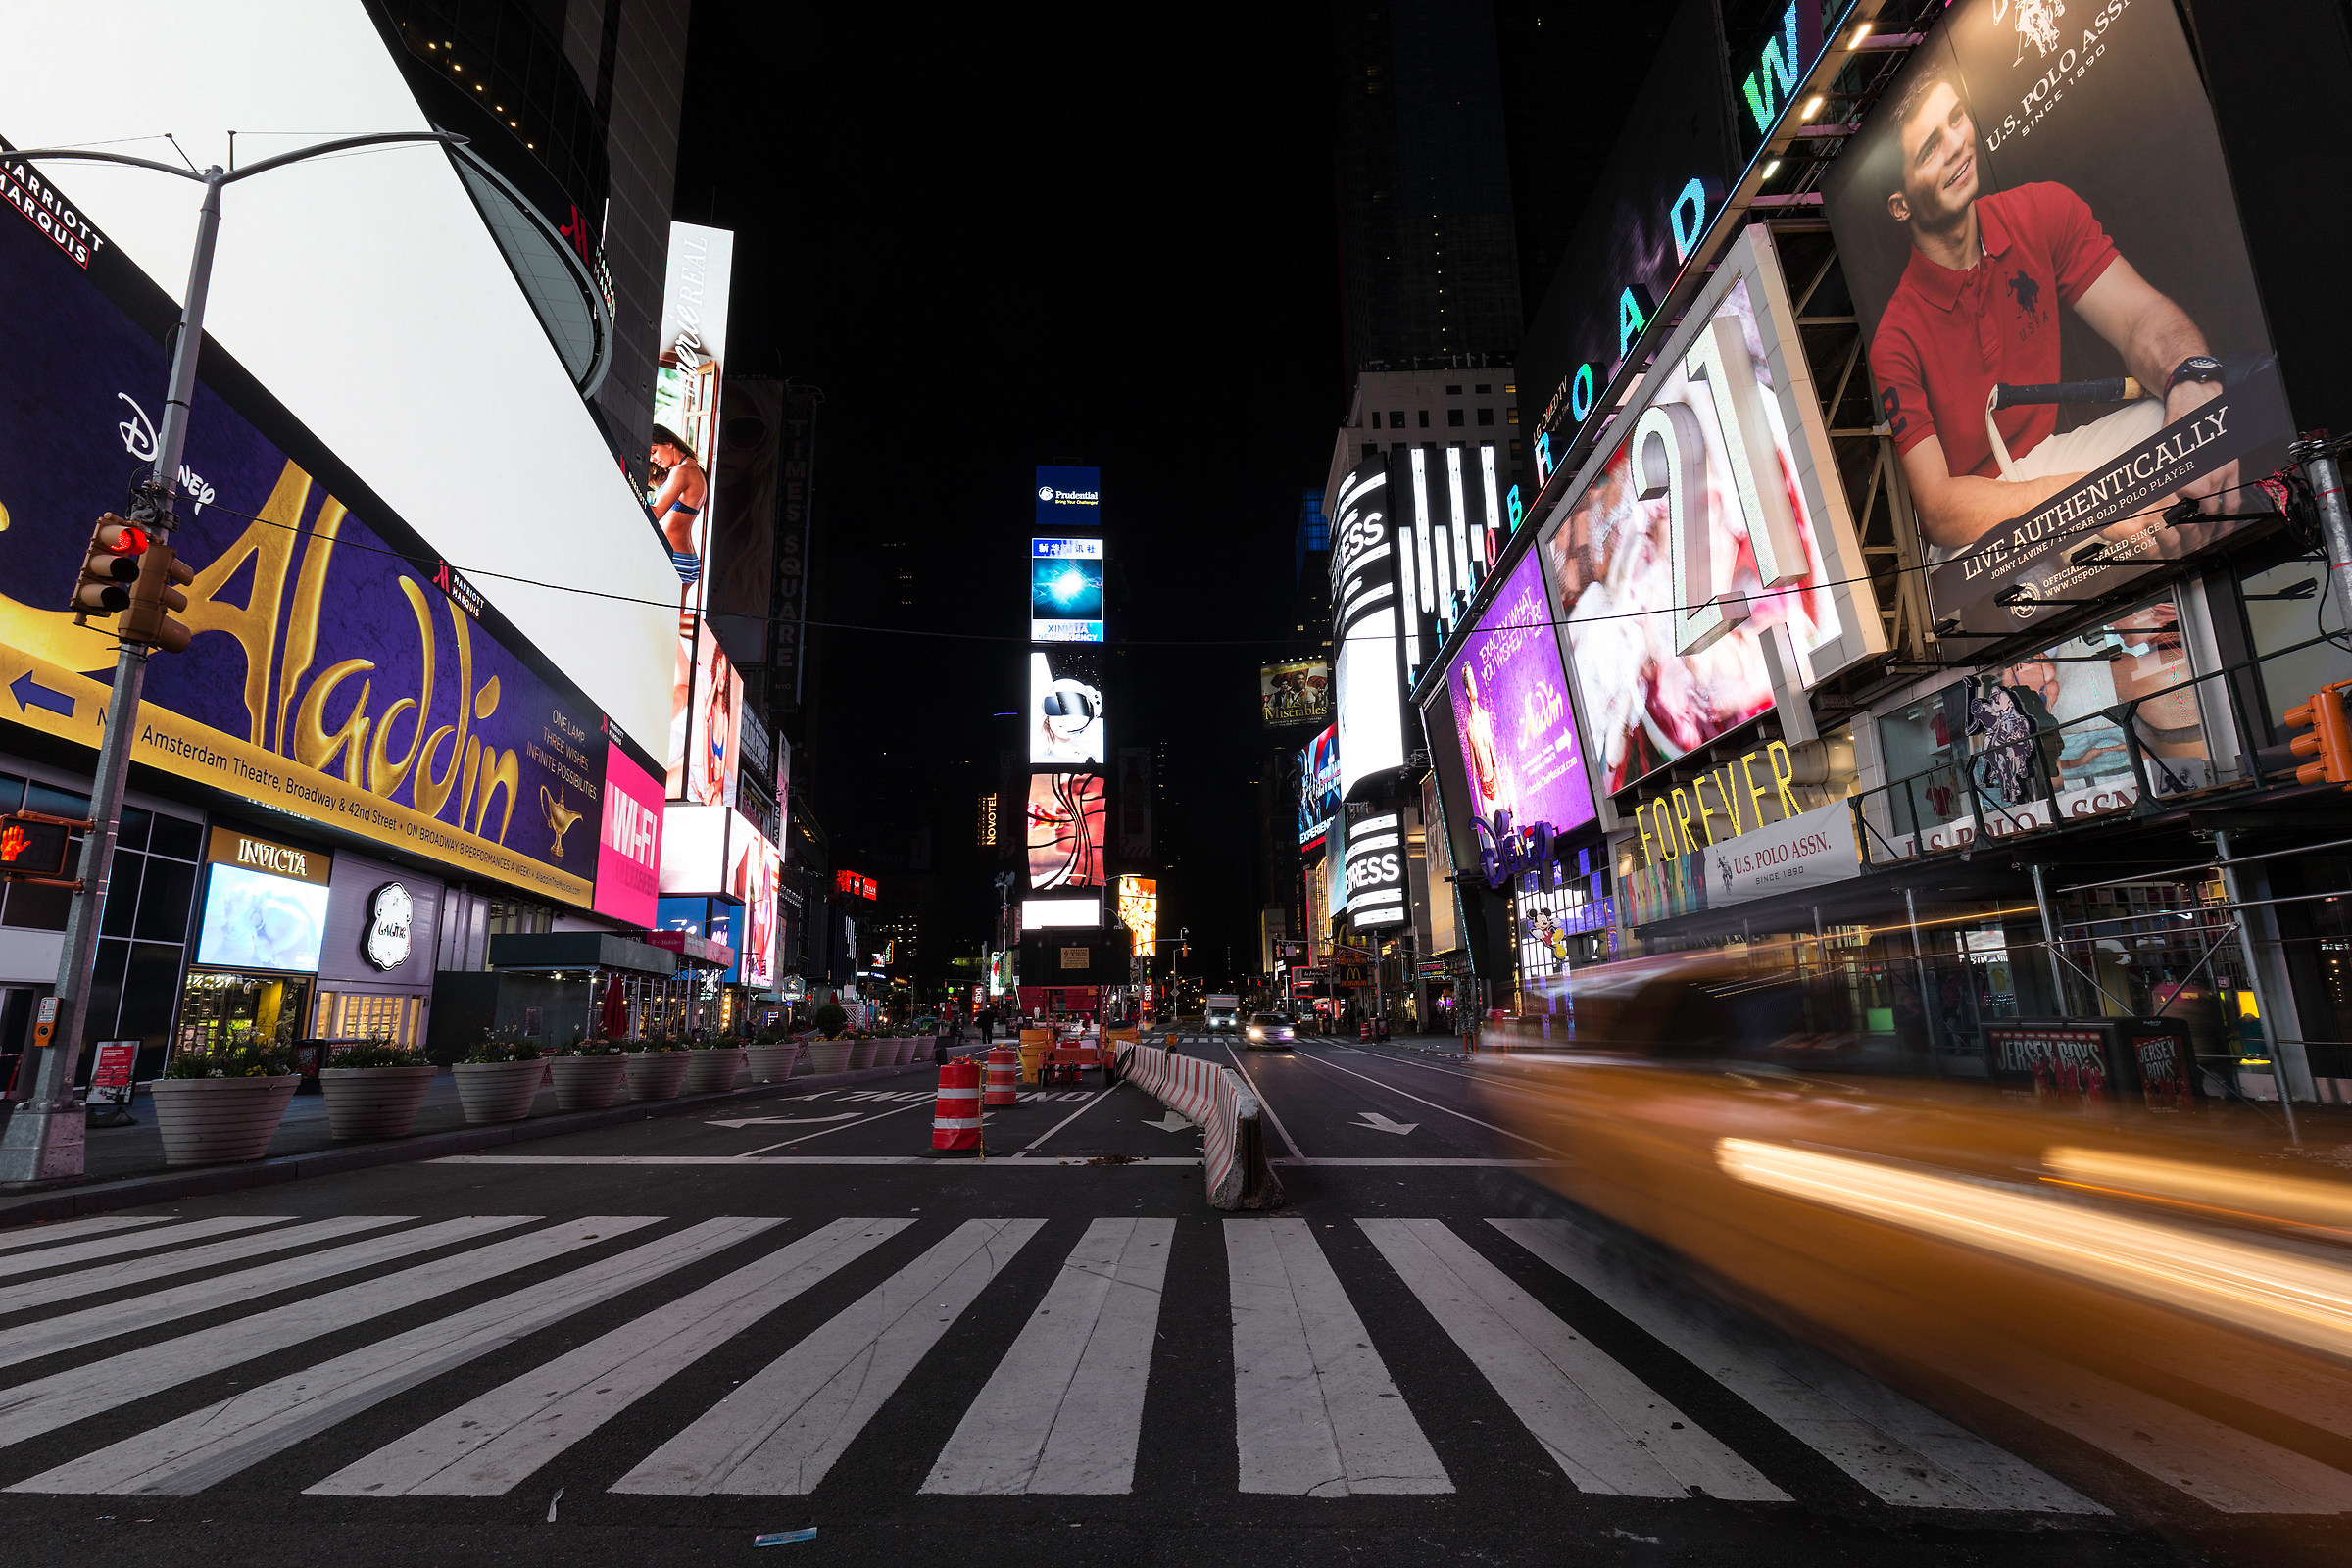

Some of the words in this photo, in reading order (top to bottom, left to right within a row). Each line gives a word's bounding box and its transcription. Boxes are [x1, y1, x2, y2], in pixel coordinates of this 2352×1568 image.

[1985, 114, 2021, 152] U.S.
[2021, 49, 2077, 116] POLO
[2021, 90, 2063, 136] SINCE
[2068, 43, 2106, 86] 1890
[2019, 311, 2050, 342] USPA
[1055, 490, 1099, 500] Prudential
[1962, 539, 2009, 581] LIVE
[2012, 405, 2229, 549] AUTHENTICALLY
[1990, 561, 2016, 580] JONNY
[2017, 543, 2049, 566] LAVINE
[2067, 514, 2096, 538] YEAR
[2096, 503, 2117, 527] OLD
[2119, 487, 2148, 509] POLO
[2150, 461, 2195, 491] PLAYER
[2131, 522, 2162, 545] SINCE
[452, 586, 480, 618] MARQUIS
[454, 574, 484, 610] MARRIOTT
[1481, 660, 1496, 686] YOU
[553, 710, 568, 732] ONE
[526, 741, 557, 773] INFINITE
[543, 726, 565, 756] THREE
[141, 724, 228, 771] Amsterdam
[233, 757, 282, 793] Theatre,
[285, 777, 337, 811] Broadway
[338, 797, 346, 812] &
[348, 800, 371, 822] 42nd
[371, 808, 398, 831] Street
[406, 821, 419, 838] ON
[419, 826, 460, 854] BROADWAY
[465, 845, 510, 872] PERFORMANCES
[1635, 739, 1804, 867] FOREVER
[237, 838, 308, 876] INVICTA
[1734, 854, 1755, 875] U.S.
[1755, 844, 1788, 869] POLO
[1791, 831, 1832, 859] ASSN.
[1755, 871, 1780, 885] SINCE
[1783, 865, 1804, 879] 1890
[1997, 1039, 2056, 1072] JERSEY
[2138, 1038, 2178, 1064] JERSEY
[2145, 1058, 2176, 1079] BOYS
